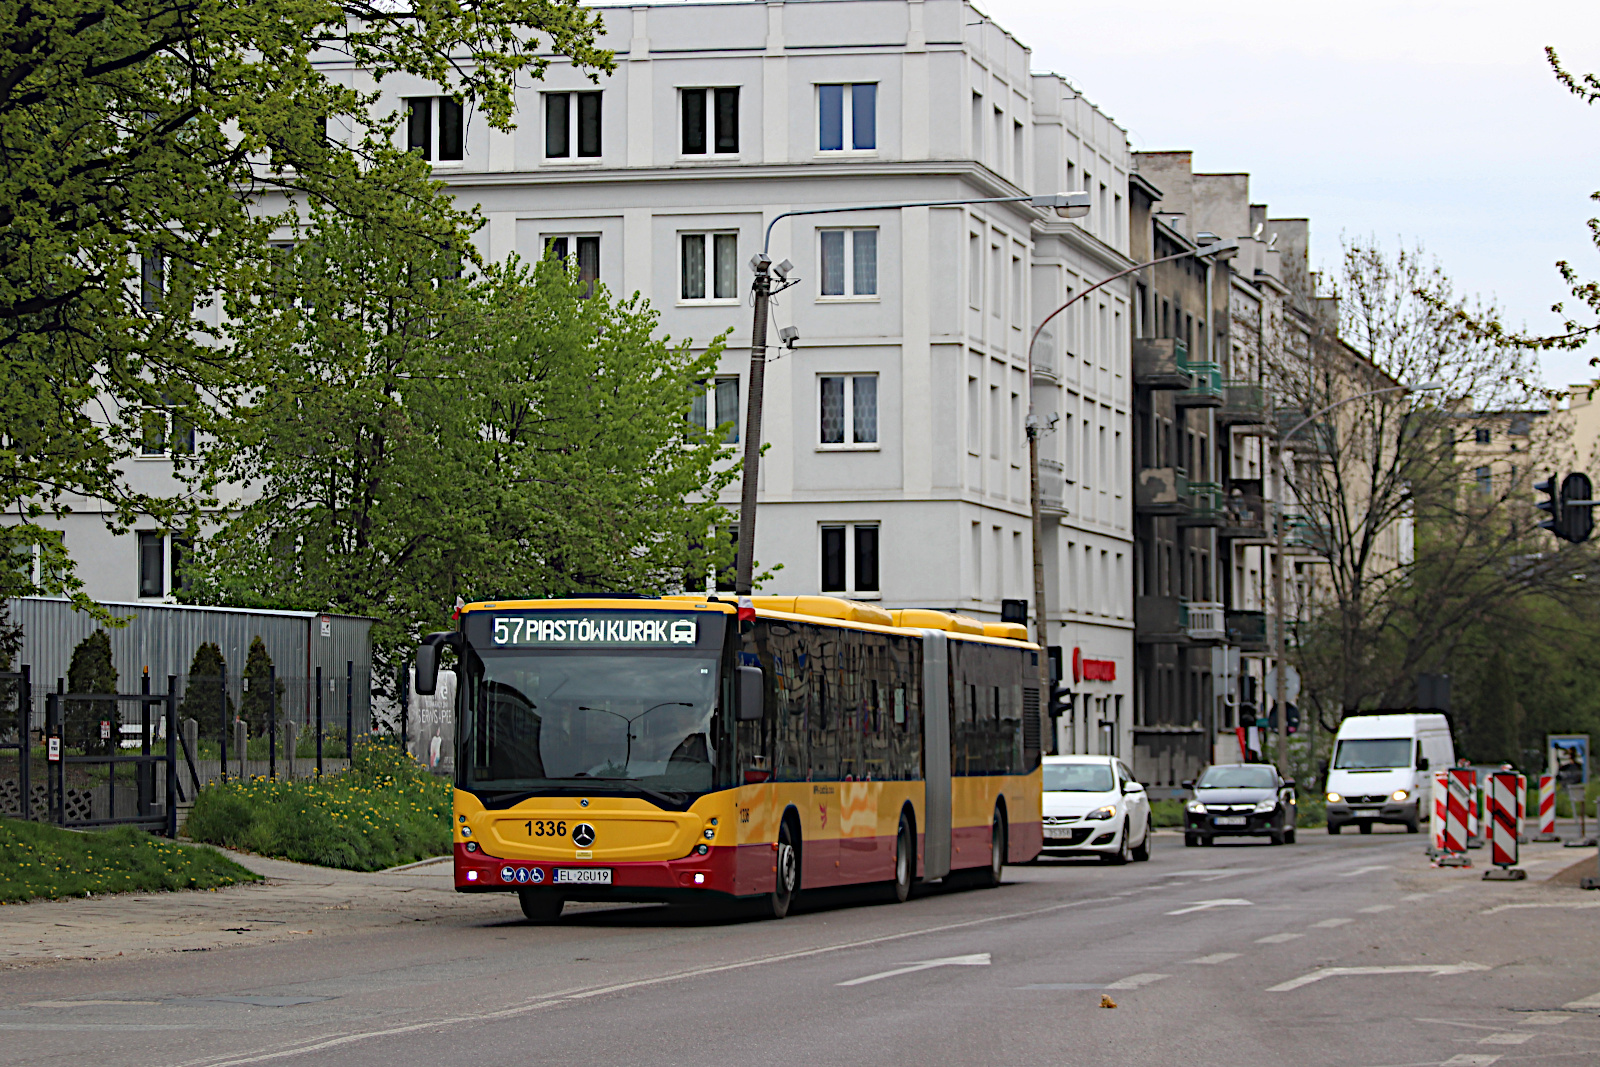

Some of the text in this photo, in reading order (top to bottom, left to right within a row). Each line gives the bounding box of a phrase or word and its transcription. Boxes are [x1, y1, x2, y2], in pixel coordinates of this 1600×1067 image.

[494, 617, 668, 644] 57 PIASTÓW KURAK
[524, 820, 567, 837] 1336
[560, 870, 609, 882] EL 2GU19
